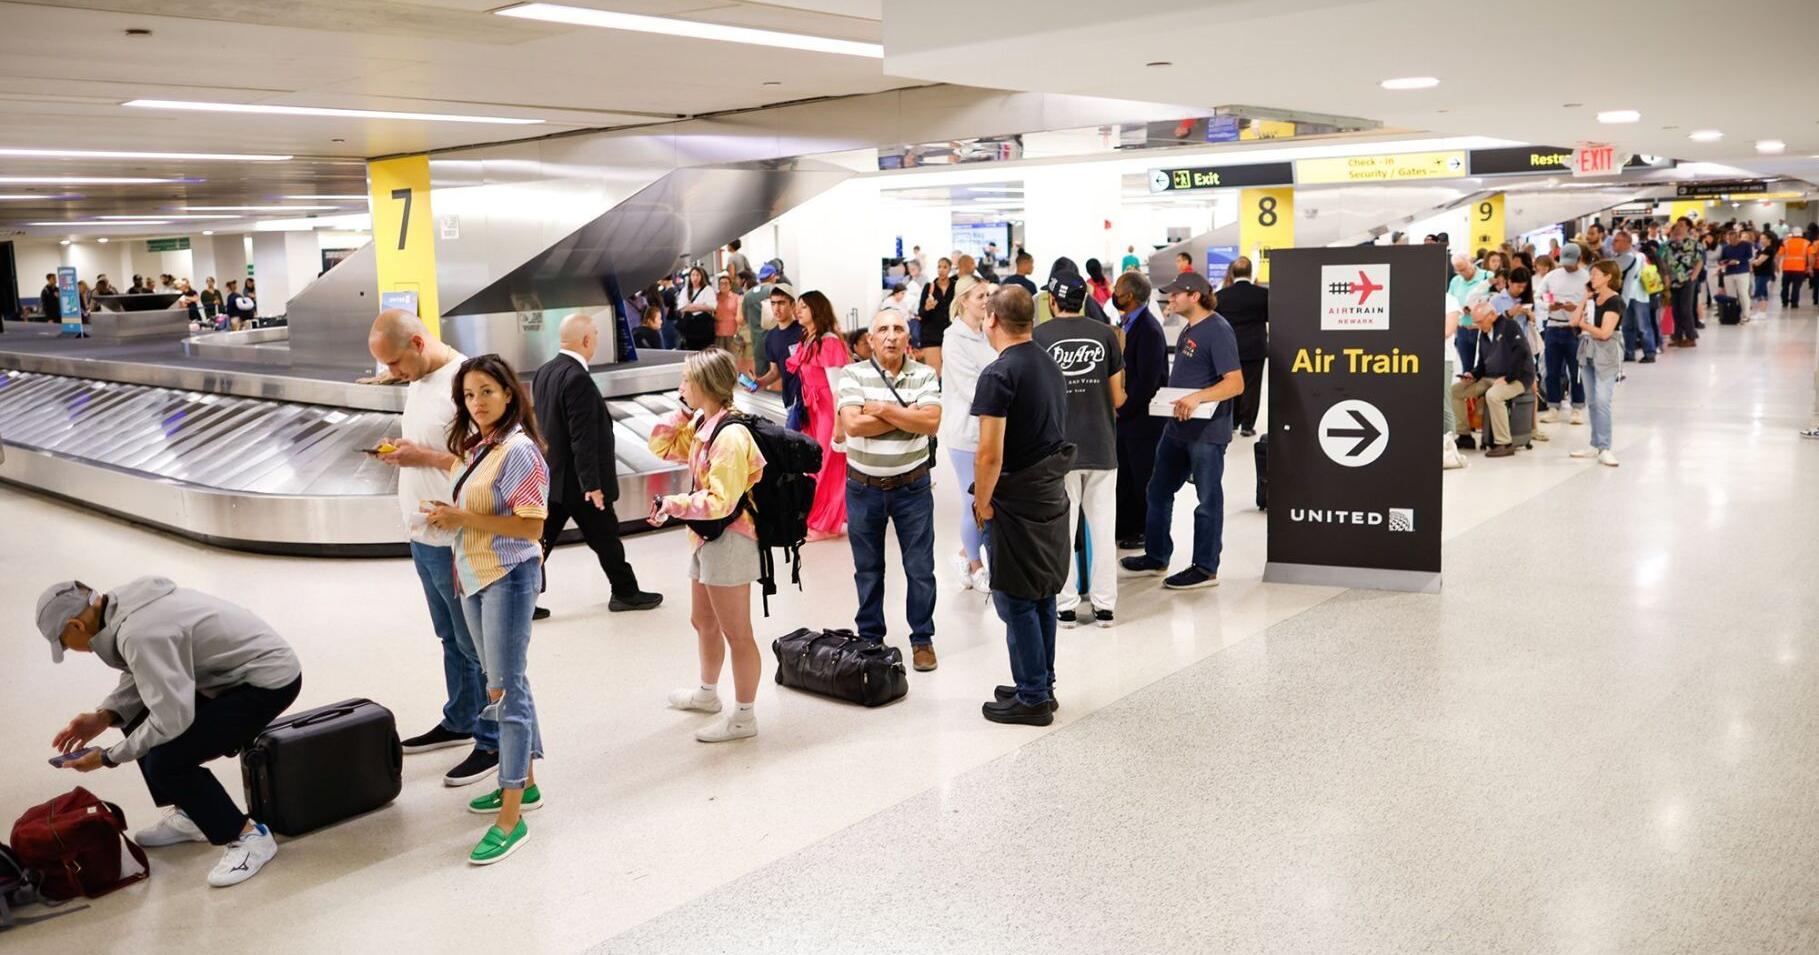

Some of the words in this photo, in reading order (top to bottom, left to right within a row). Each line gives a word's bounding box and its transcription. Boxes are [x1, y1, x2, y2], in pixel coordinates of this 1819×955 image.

[1348, 159, 1376, 167] Check
[1530, 153, 1572, 166] Restr
[1580, 148, 1613, 172] EXIT
[1194, 172, 1220, 186] Exit
[1349, 168, 1387, 179] Security
[1398, 167, 1427, 176] Gates
[391, 187, 412, 250] 7
[1258, 196, 1277, 227] 8
[1480, 201, 1493, 222] 9
[1328, 306, 1384, 314] AIRTRAIN
[1053, 345, 1104, 370] DuArt
[1291, 347, 1336, 374] Air
[1342, 347, 1420, 374] Train
[1290, 508, 1383, 525] UNITED
